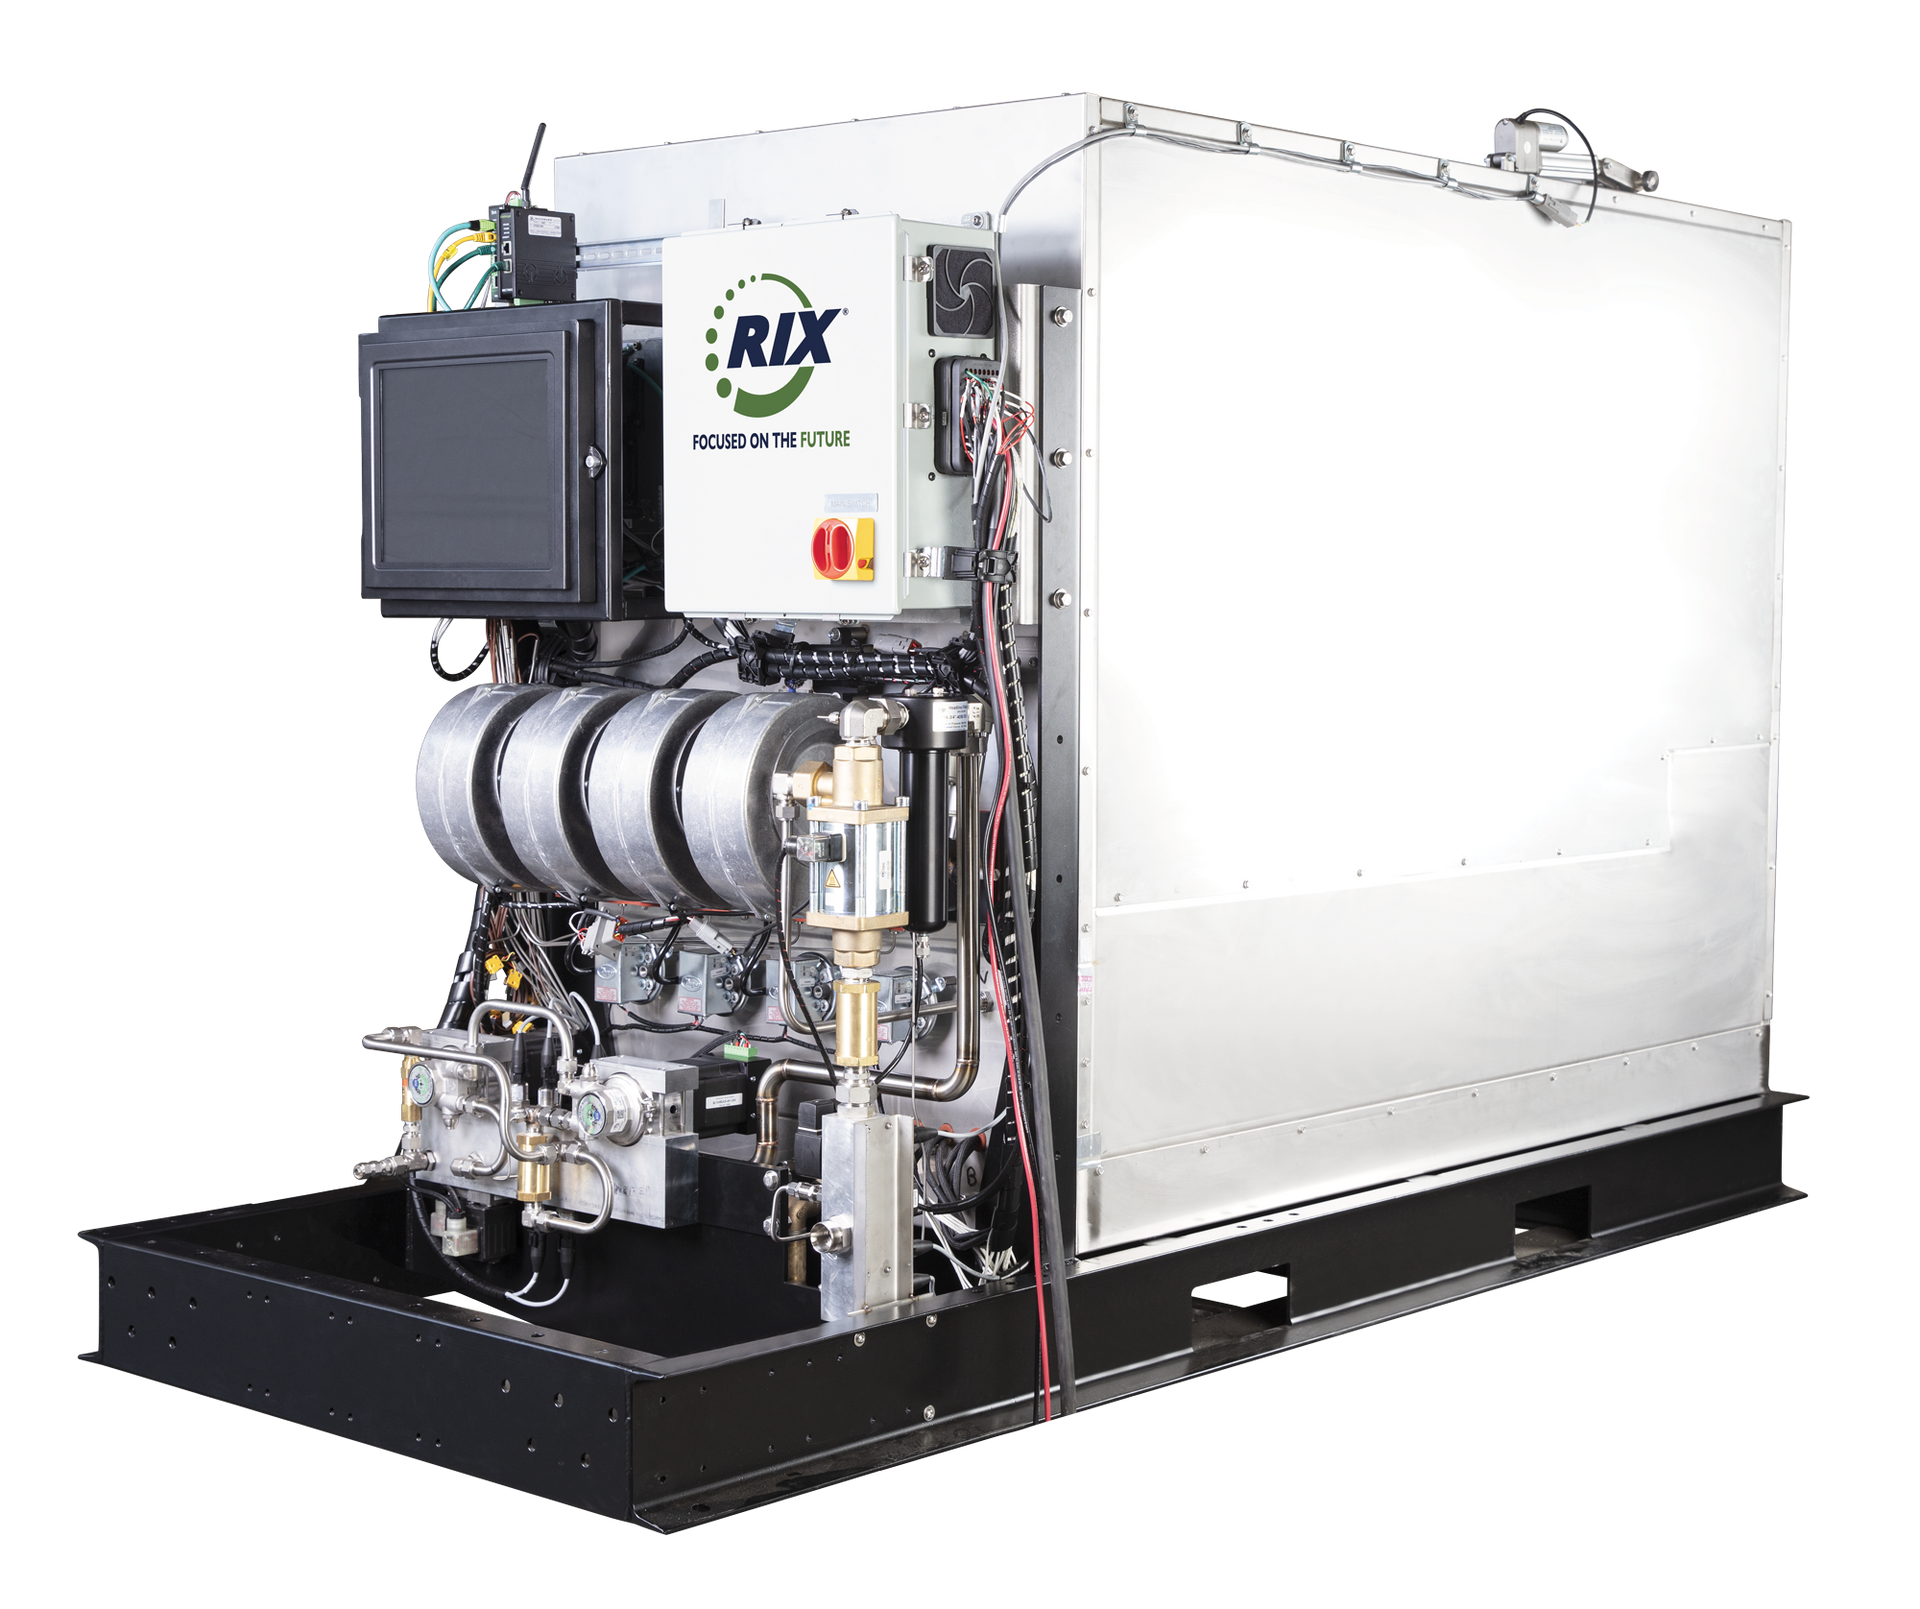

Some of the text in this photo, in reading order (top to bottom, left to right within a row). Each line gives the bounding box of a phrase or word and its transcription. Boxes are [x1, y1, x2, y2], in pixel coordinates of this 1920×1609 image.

[727, 308, 842, 369] RIX
[693, 430, 850, 450] FOCUSED ON THE FUTURE
[847, 499, 871, 507] SWITCH
